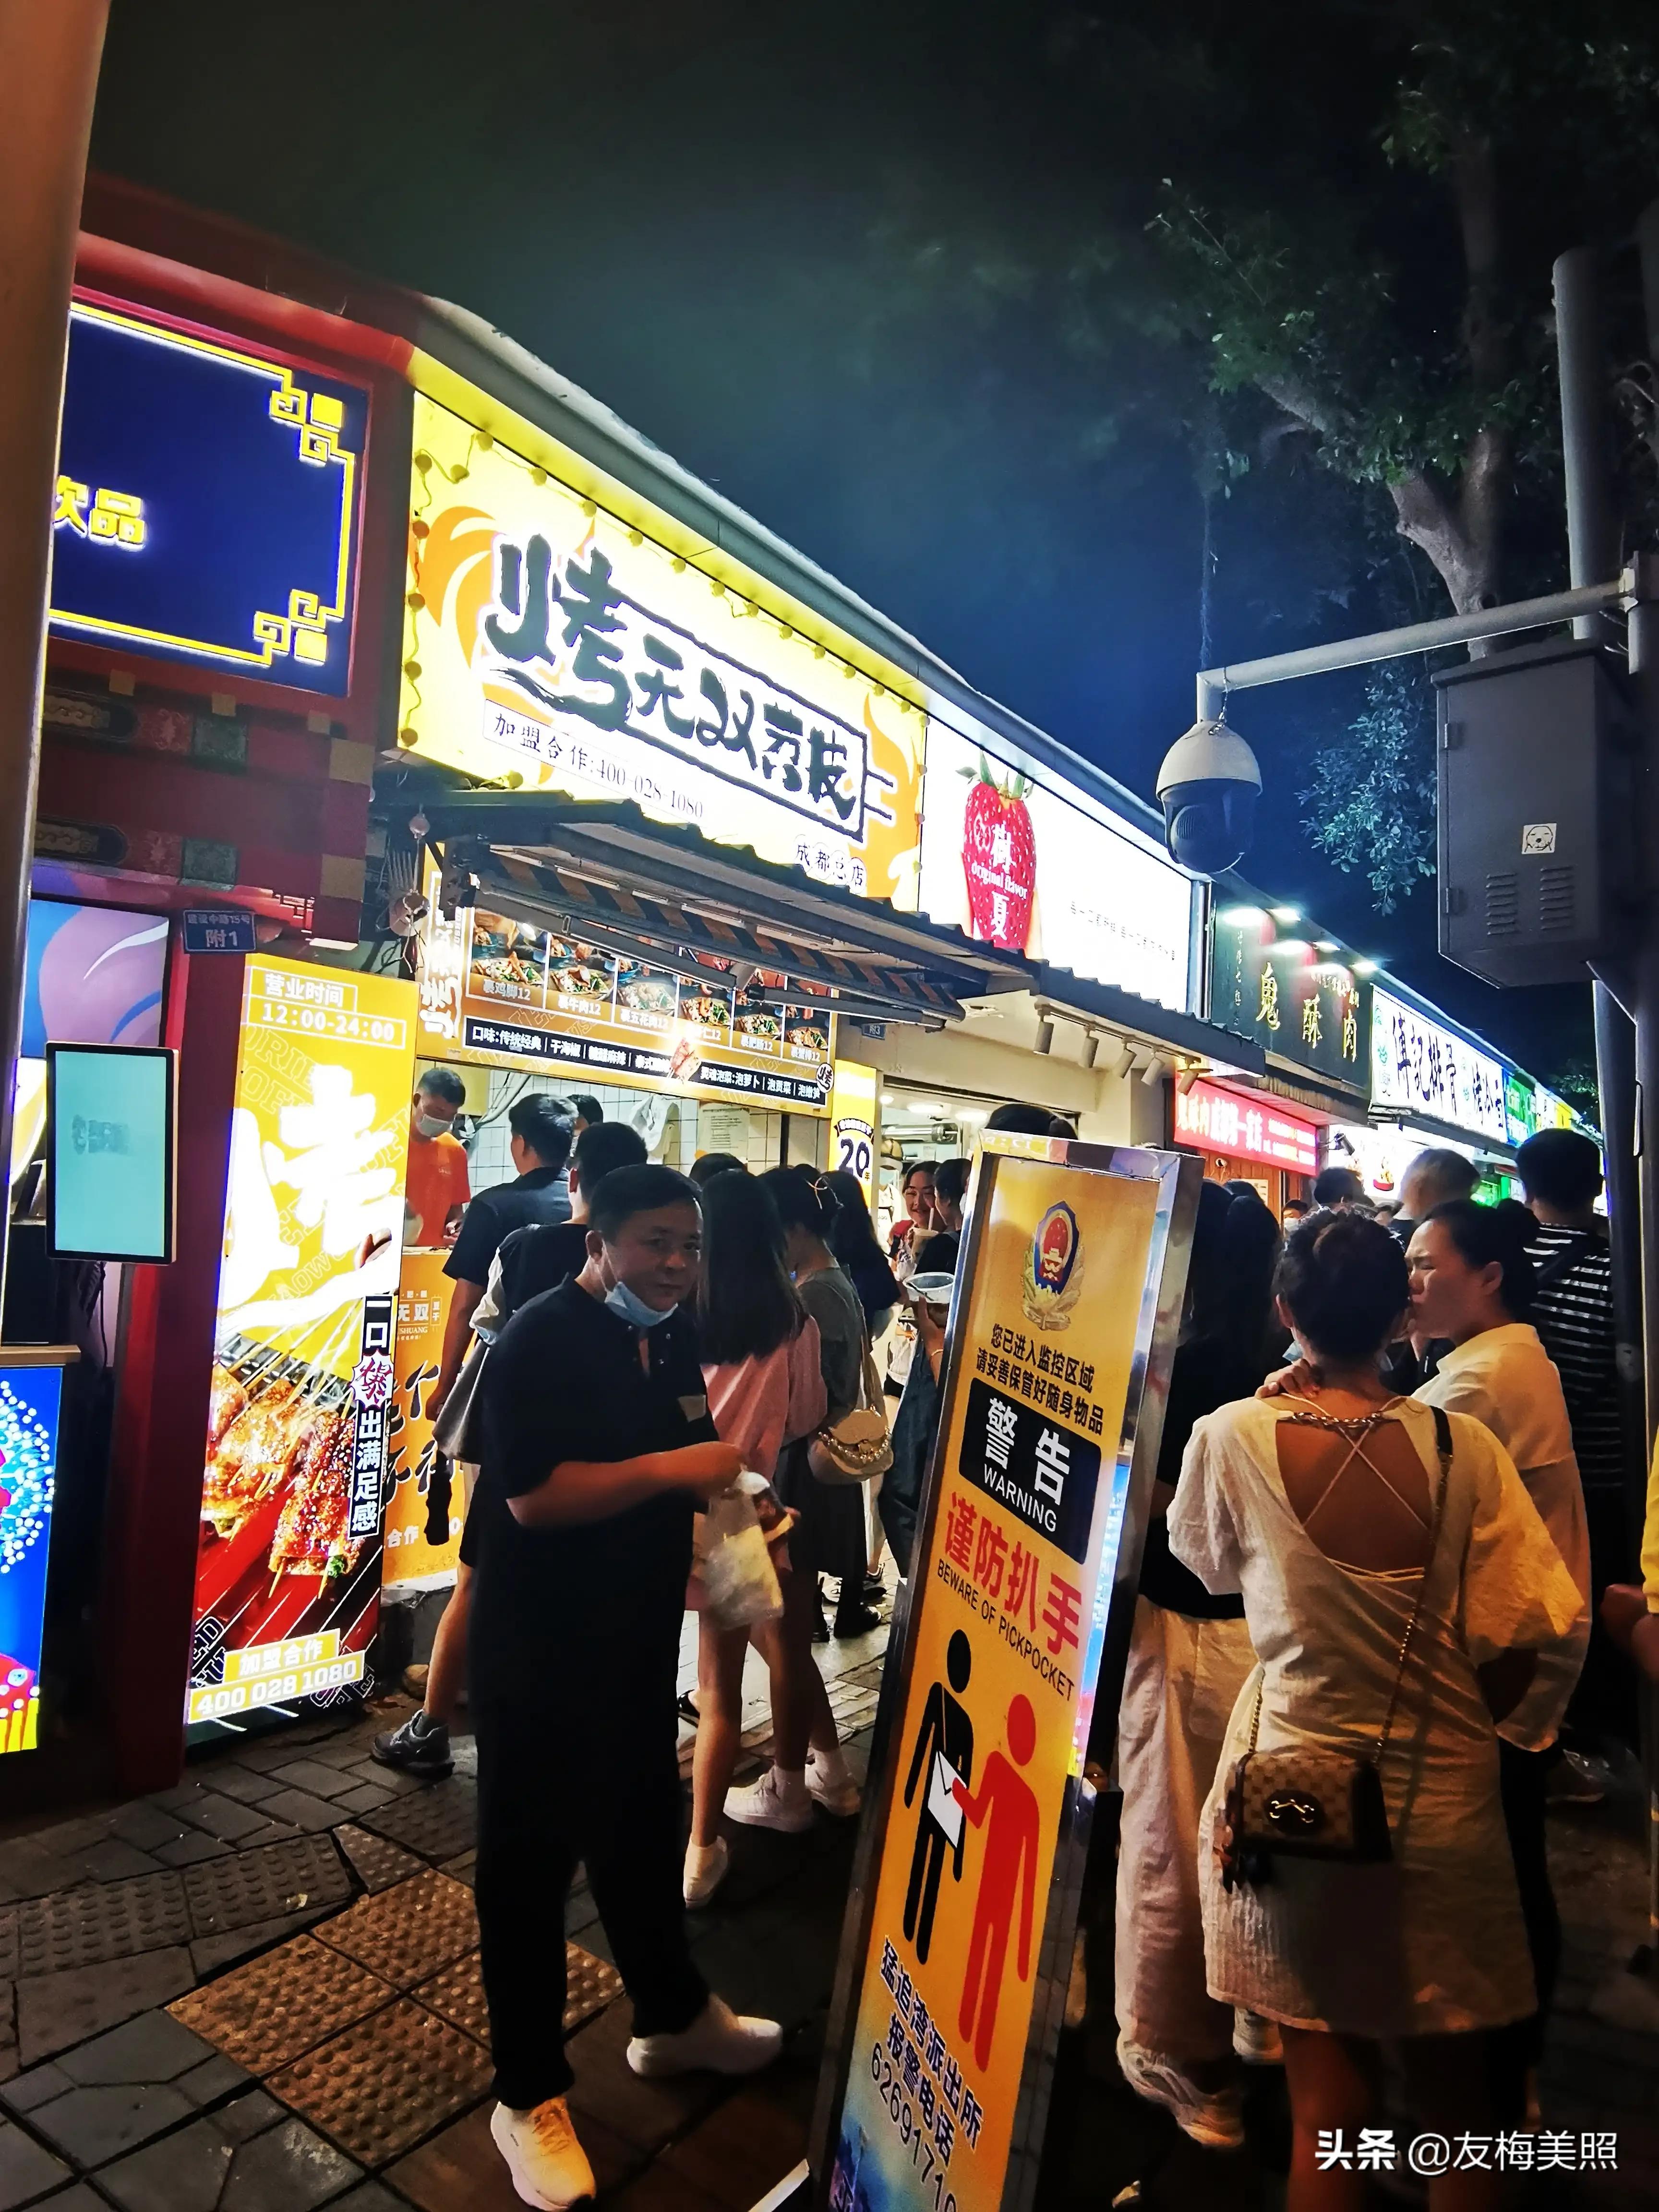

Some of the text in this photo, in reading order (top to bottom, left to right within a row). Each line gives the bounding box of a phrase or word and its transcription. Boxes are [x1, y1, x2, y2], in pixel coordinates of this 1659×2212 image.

[796, 843, 864, 887] 成都总店
[1005, 875, 1028, 900] flavor
[205, 929, 238, 948] 附1
[262, 1003, 395, 1041] 12:00-24:00
[265, 973, 344, 1007] 营业时间
[1256, 962, 1357, 1062] 鬼酥肉
[976, 1347, 1104, 1436] 请妥善保管好随身物品
[990, 1323, 1095, 1393] 您已进入监控区域
[985, 1397, 1070, 1506] 警告
[984, 1463, 1057, 1533] WARNING
[945, 1491, 1082, 1656] 谨防扒手
[240, 1639, 323, 1675] 加盟合作
[937, 1558, 1076, 1702] BEWARE OF PICKPOCKET
[197, 1687, 246, 1716] 400
[252, 1675, 297, 1702] 028
[302, 1660, 357, 1691] 1080
[881, 1935, 983, 2152] 猛追湾派出所
[888, 2012, 954, 2168] 报警电话
